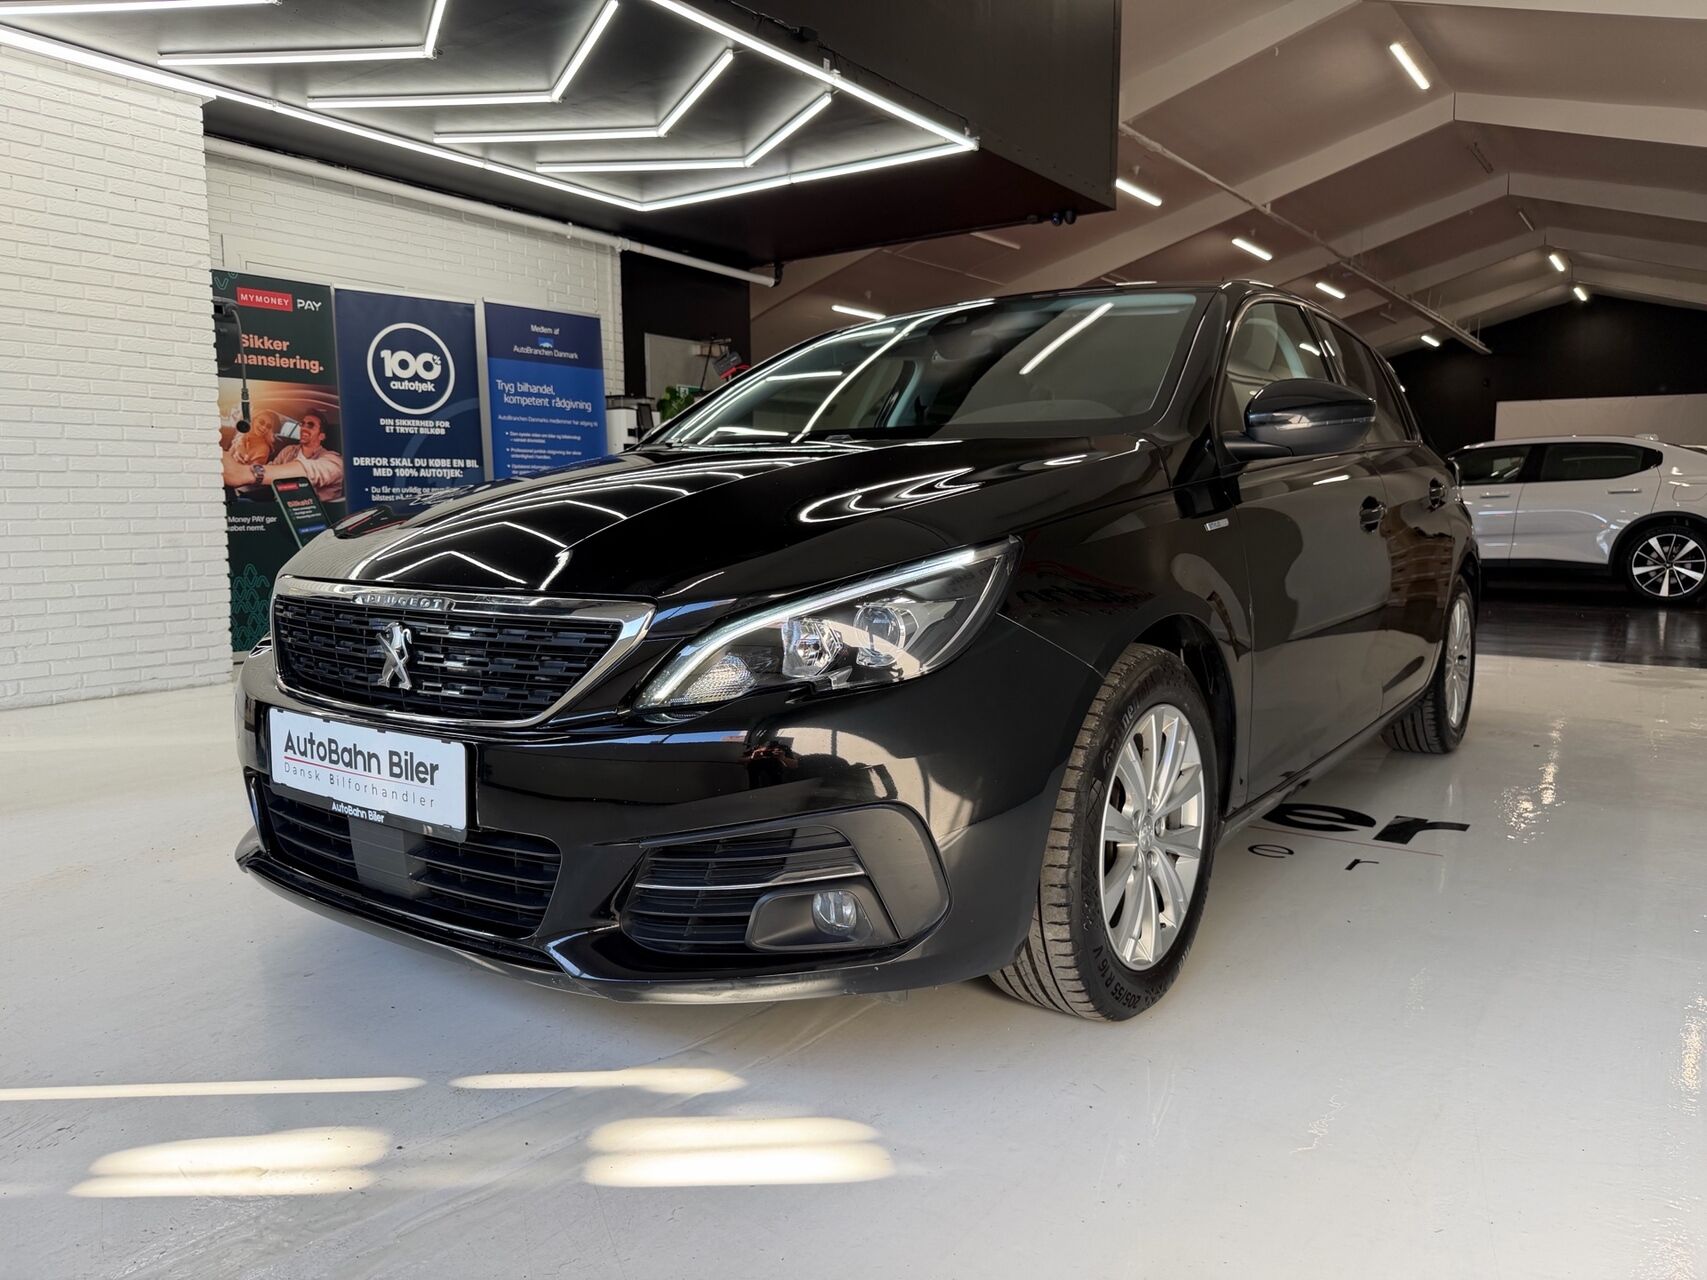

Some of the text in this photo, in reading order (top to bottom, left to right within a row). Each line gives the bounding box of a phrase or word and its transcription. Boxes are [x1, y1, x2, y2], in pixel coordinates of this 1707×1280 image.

[240, 293, 322, 312] MYMONEY PAY
[530, 324, 553, 334] Medlem
[241, 333, 290, 351] Sikker
[513, 345, 579, 360] AutoBranchen Danmark
[390, 380, 436, 393] autotjek
[496, 379, 556, 396] Tryg bilhandel,
[503, 394, 592, 412] kompetent rådgivning
[379, 418, 451, 428] DIN SIKKERHED FOR
[396, 426, 419, 434] TRYGT
[419, 426, 446, 435] BILKØB
[353, 457, 480, 468] DERFOR SKAL DU KØBE EN BIL
[372, 468, 464, 479] MED 100% AUTOTJEK:
[381, 485, 391, 493] får
[227, 515, 251, 524] Money
[251, 514, 265, 523] PAY
[366, 594, 443, 609] PEUGEOT
[283, 729, 440, 786] AutoBahn Biler
[284, 761, 435, 808] Dansk Bilforhandler
[331, 801, 385, 824] AutoBahn Biler
[1098, 959, 1111, 977] 16
[1111, 981, 1142, 1010] 205/55
